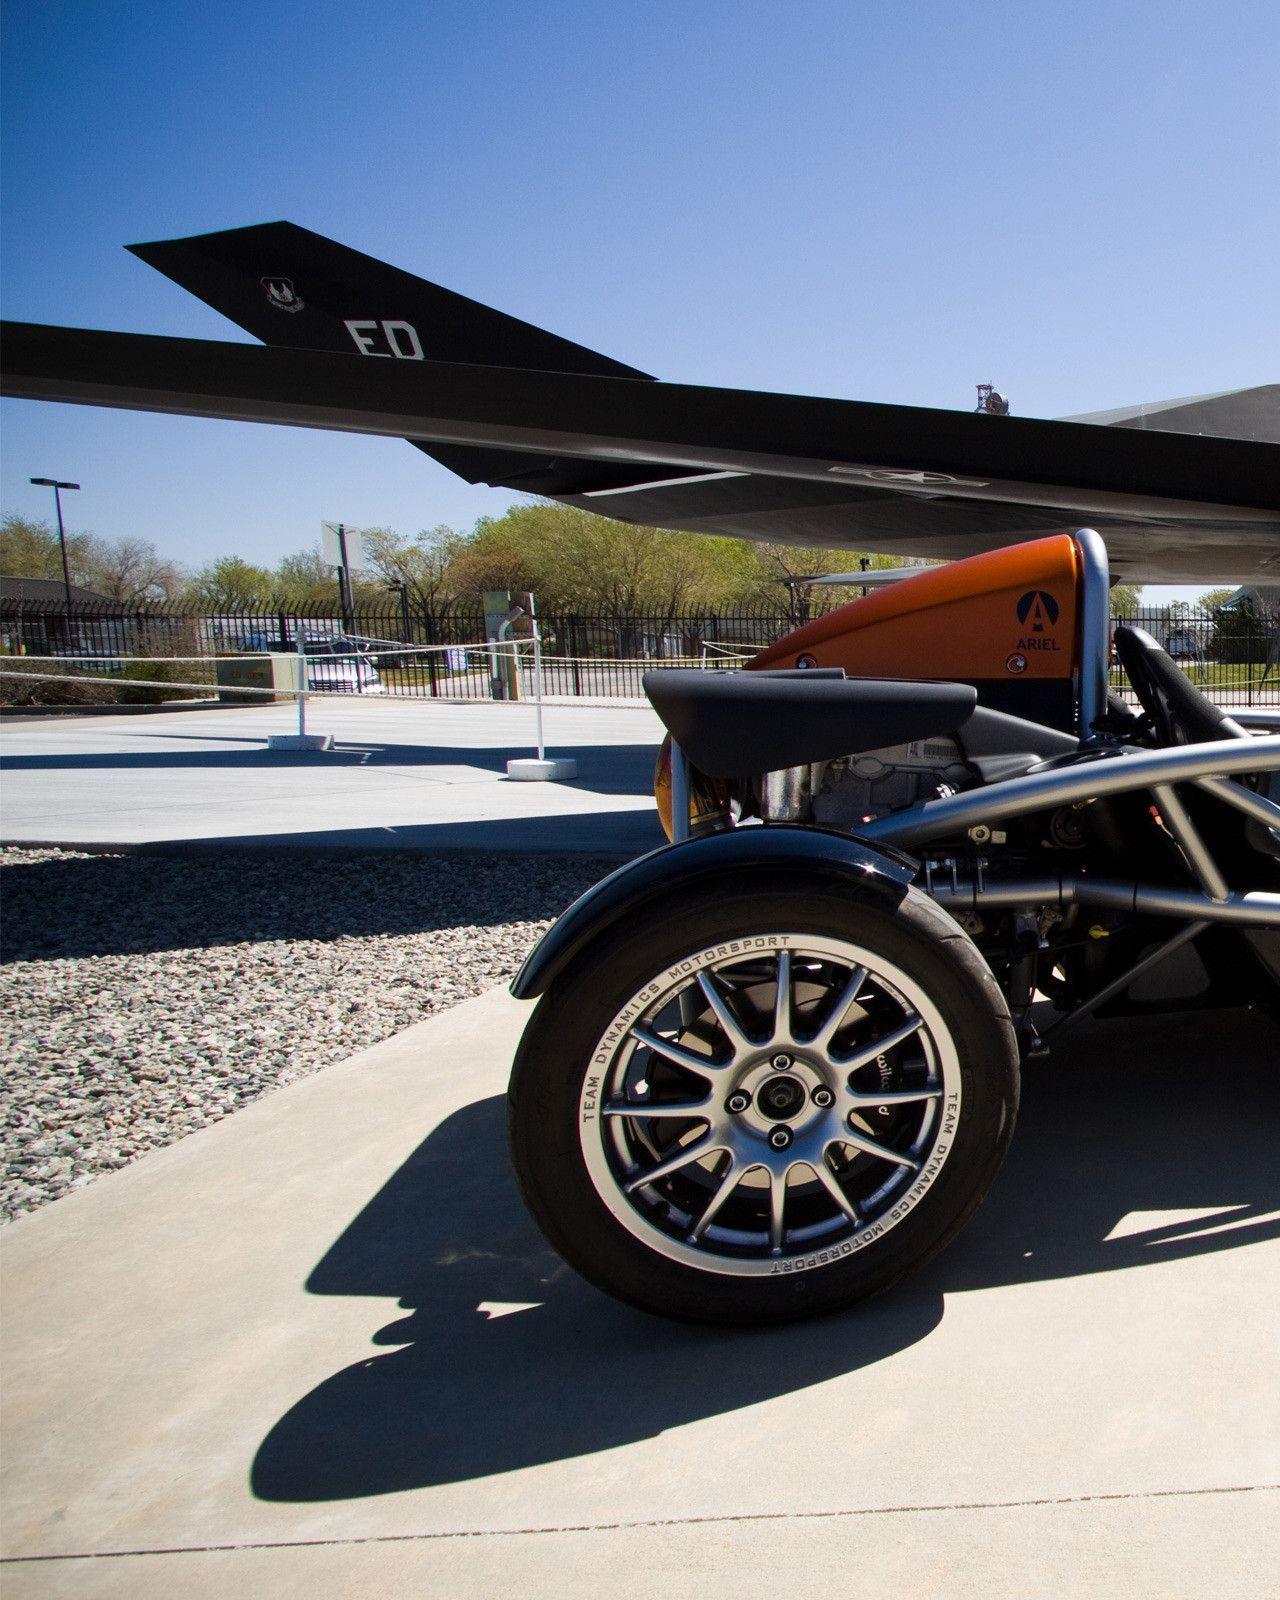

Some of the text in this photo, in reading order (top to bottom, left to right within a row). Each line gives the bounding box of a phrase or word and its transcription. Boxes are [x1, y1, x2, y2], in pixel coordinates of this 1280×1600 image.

[343, 320, 425, 360] ED
[1016, 639, 1060, 651] ARIEL
[583, 1076, 600, 1123] TEAM
[595, 983, 660, 1064] DYNAMICS
[668, 936, 790, 979] MOTORSPORT
[770, 1092, 958, 1273] TEAM DYNAMICS MOTORSPORT
